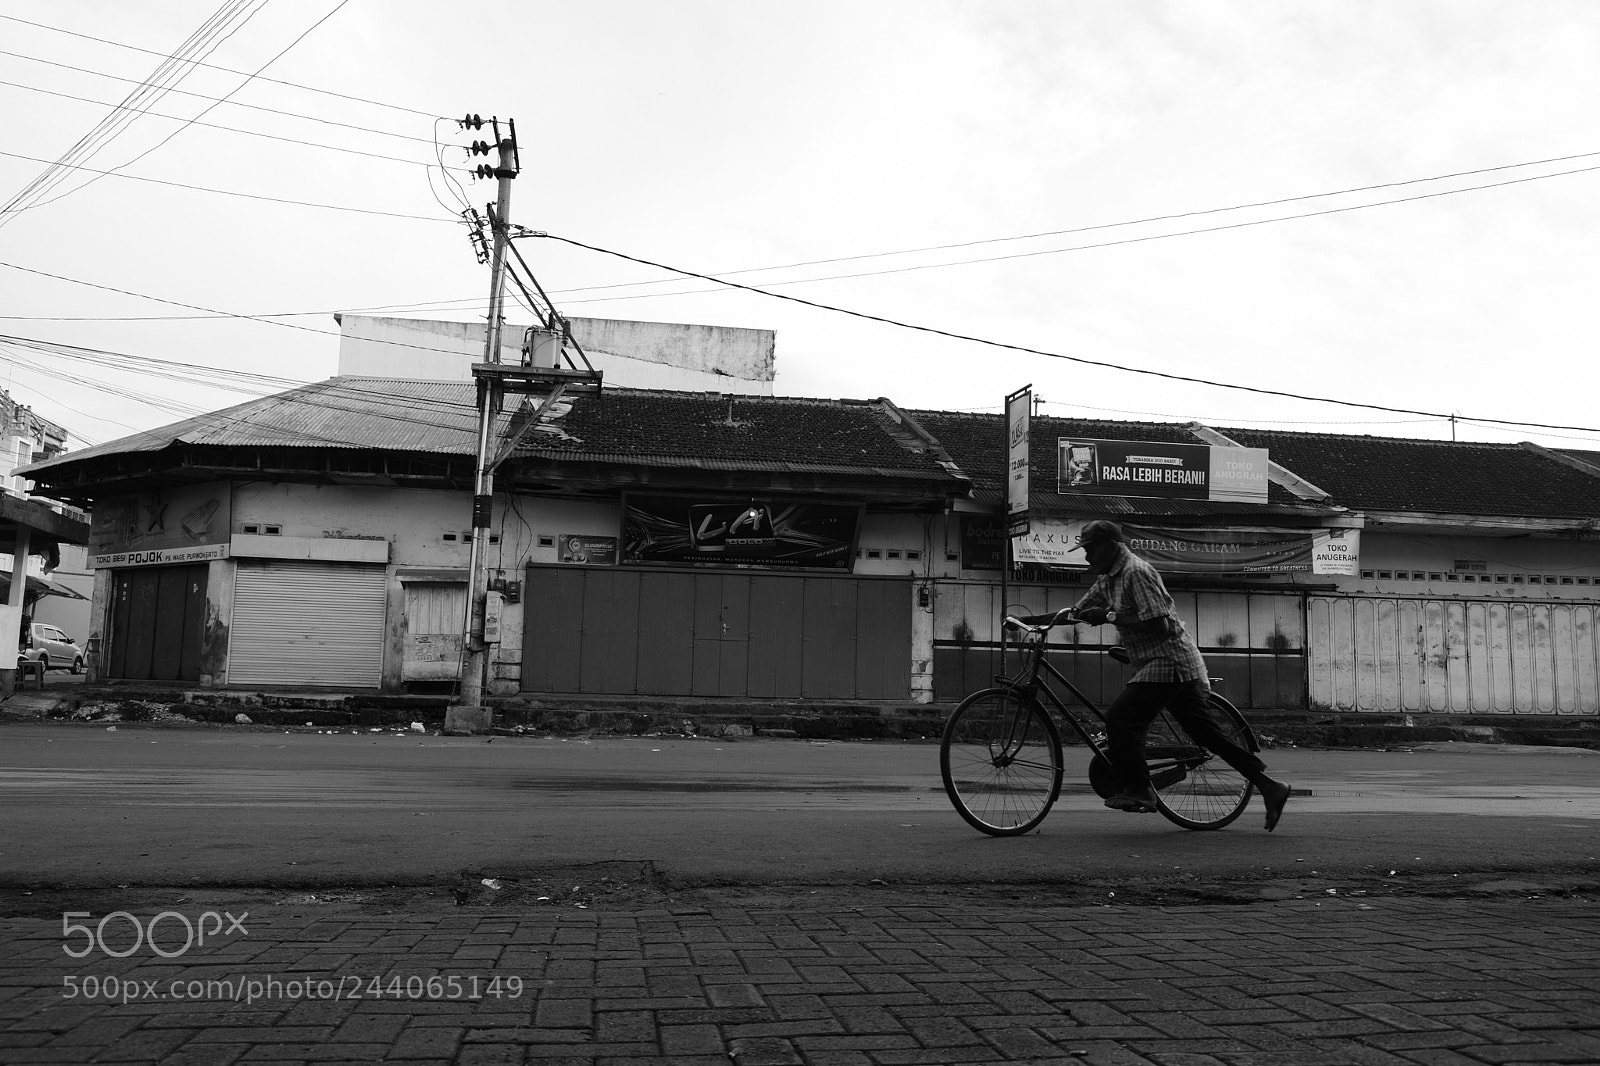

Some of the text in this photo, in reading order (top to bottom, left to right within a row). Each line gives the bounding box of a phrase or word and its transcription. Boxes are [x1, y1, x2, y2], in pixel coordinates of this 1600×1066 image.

[1225, 461, 1252, 470] TOKO
[1102, 466, 1205, 485] RASA LEBIH BERANI!
[1213, 470, 1264, 481] ANUGRAH
[1018, 533, 1082, 545] MAXUS
[1130, 539, 1188, 552] GUDANG
[1190, 542, 1241, 554] GARAM
[1326, 544, 1348, 552] TOKO
[96, 556, 111, 564] TOKO
[112, 555, 126, 563] BESI
[128, 551, 163, 564] POJOK
[1316, 553, 1357, 562] ANUGERAH
[1010, 569, 1081, 583] TOKO ANUGRAH
